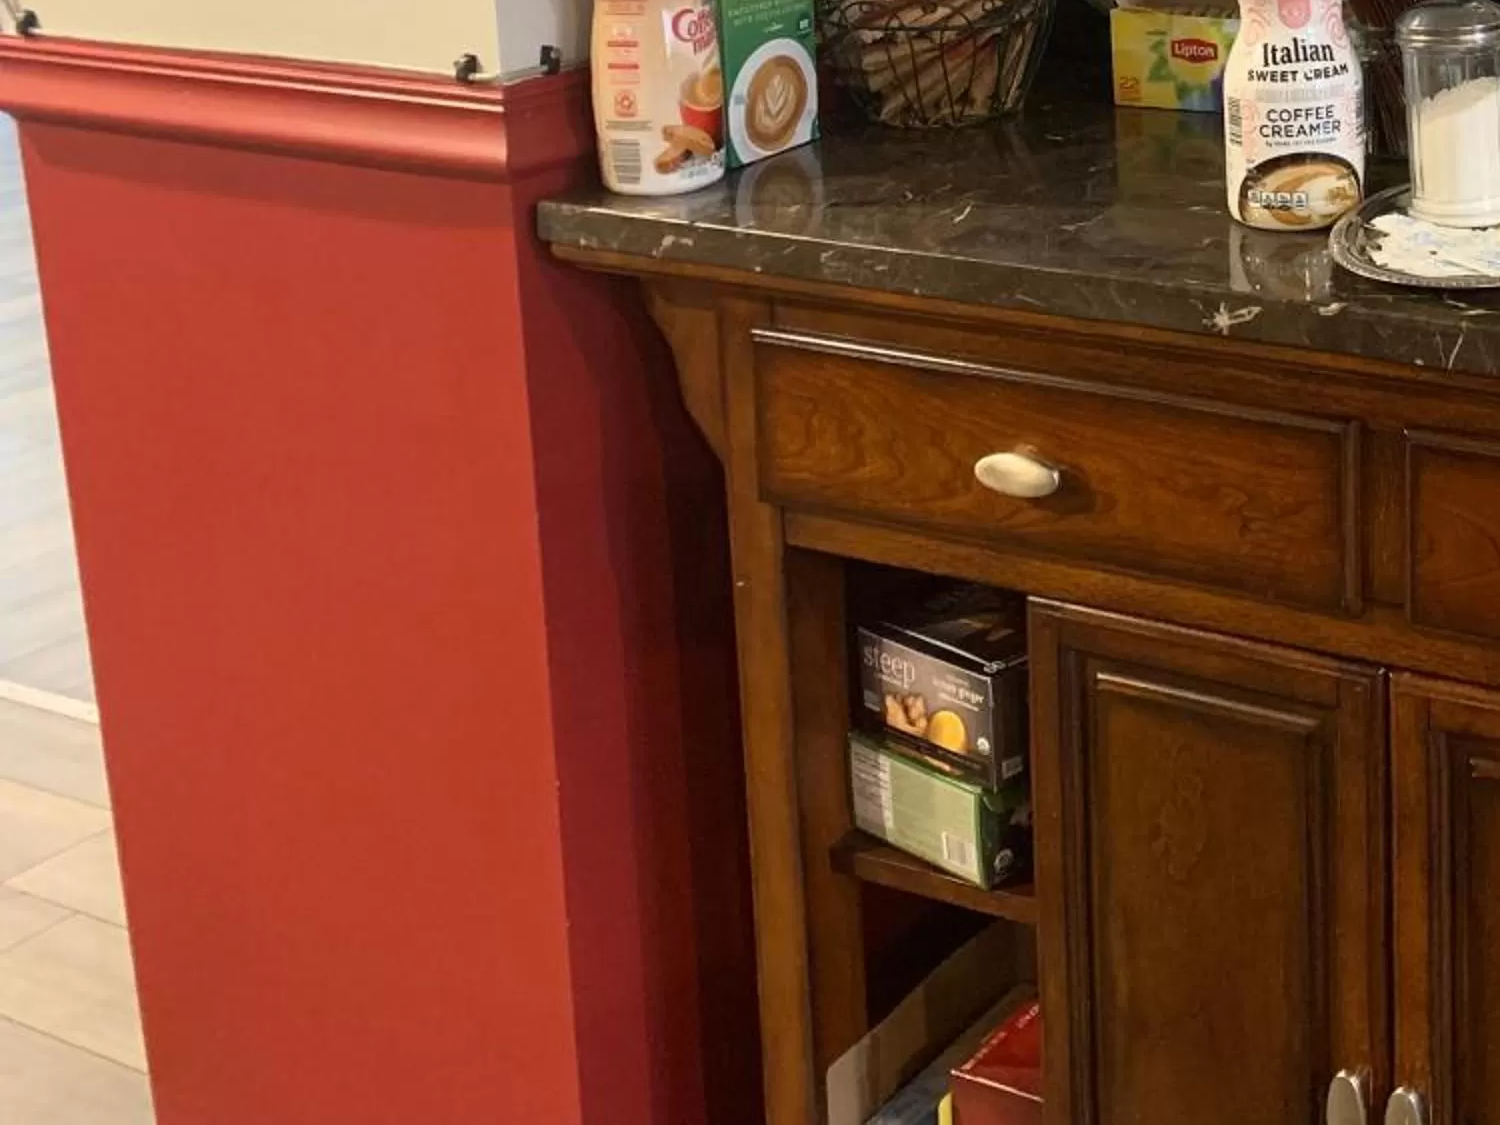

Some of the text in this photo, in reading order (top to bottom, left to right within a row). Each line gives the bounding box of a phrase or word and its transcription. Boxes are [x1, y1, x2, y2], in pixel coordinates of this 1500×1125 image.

[1173, 42, 1215, 58] Lipton
[1262, 36, 1336, 68] Italian
[1247, 62, 1349, 83] SWEET CREAM
[1266, 104, 1336, 123] COFFEE
[1259, 119, 1341, 139] CREAMER
[863, 643, 916, 690] steep
